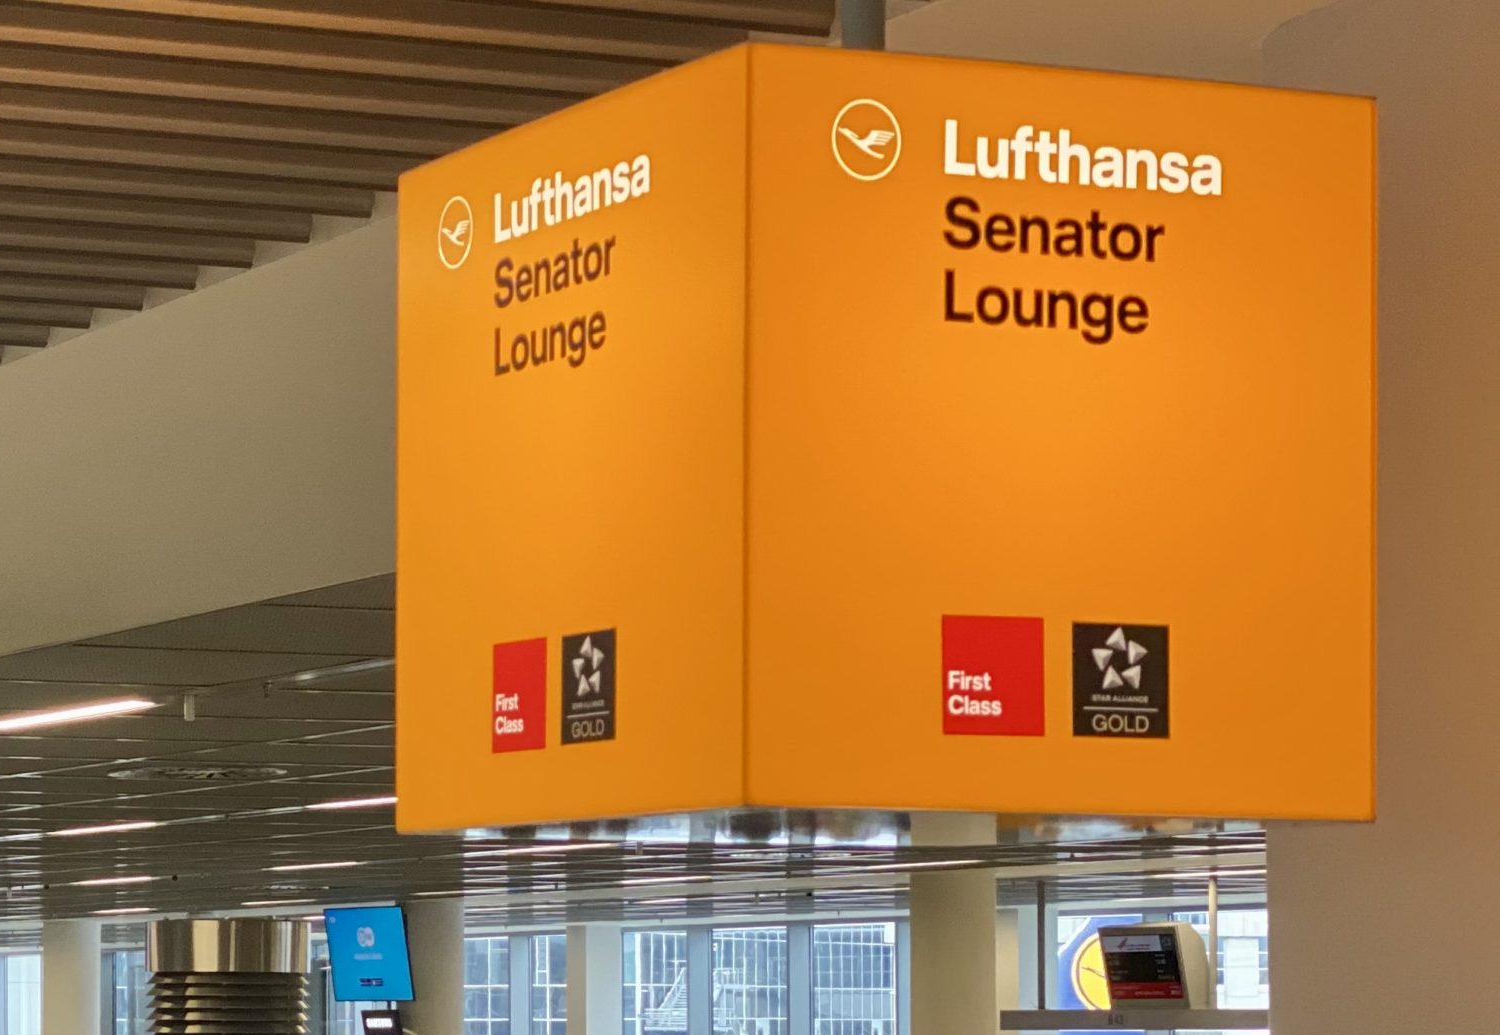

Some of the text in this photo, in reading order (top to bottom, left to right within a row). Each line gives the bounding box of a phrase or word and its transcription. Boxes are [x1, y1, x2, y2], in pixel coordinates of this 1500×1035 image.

[943, 118, 1223, 196] Lufthansa
[494, 153, 651, 244] Lufthansa
[942, 195, 1166, 263] Senator
[494, 234, 617, 309] Senator
[943, 268, 1150, 346] Lounge
[494, 310, 607, 377] Lounge
[495, 692, 519, 712] First
[947, 669, 992, 692] First
[495, 715, 525, 736] Class
[947, 694, 1003, 717] Class
[1091, 713, 1150, 733] GOLD
[571, 718, 605, 739] GOLD
